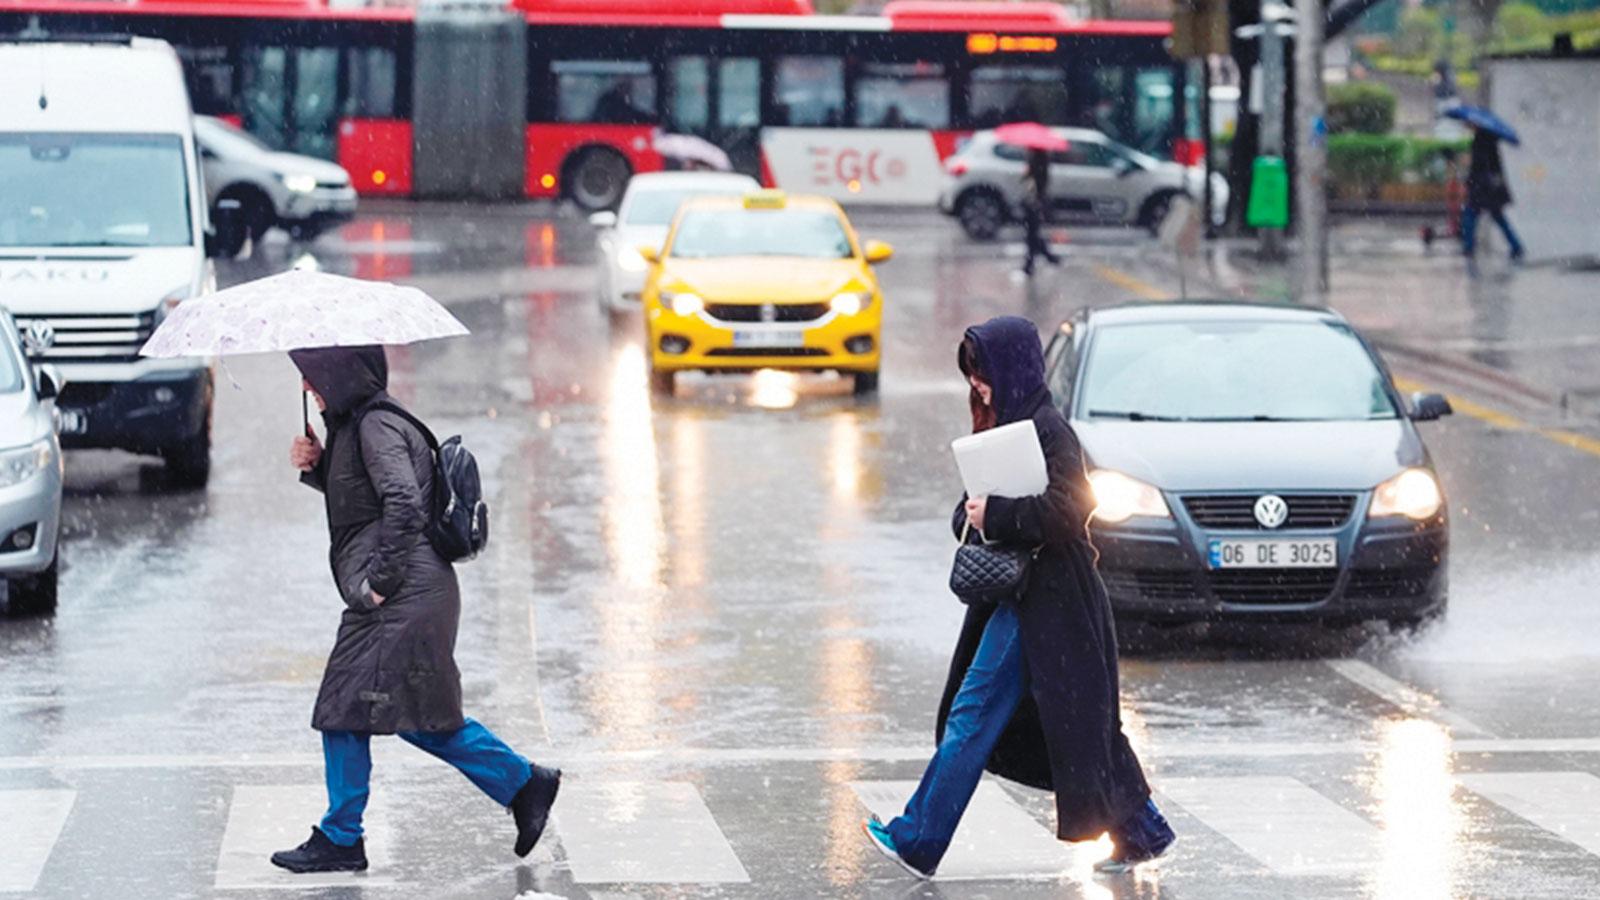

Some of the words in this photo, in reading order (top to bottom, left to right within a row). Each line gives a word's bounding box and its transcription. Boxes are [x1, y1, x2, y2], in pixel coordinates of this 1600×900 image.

[1222, 543, 1245, 564] 06
[1257, 543, 1279, 564] DE
[1290, 543, 1334, 564] 3025
